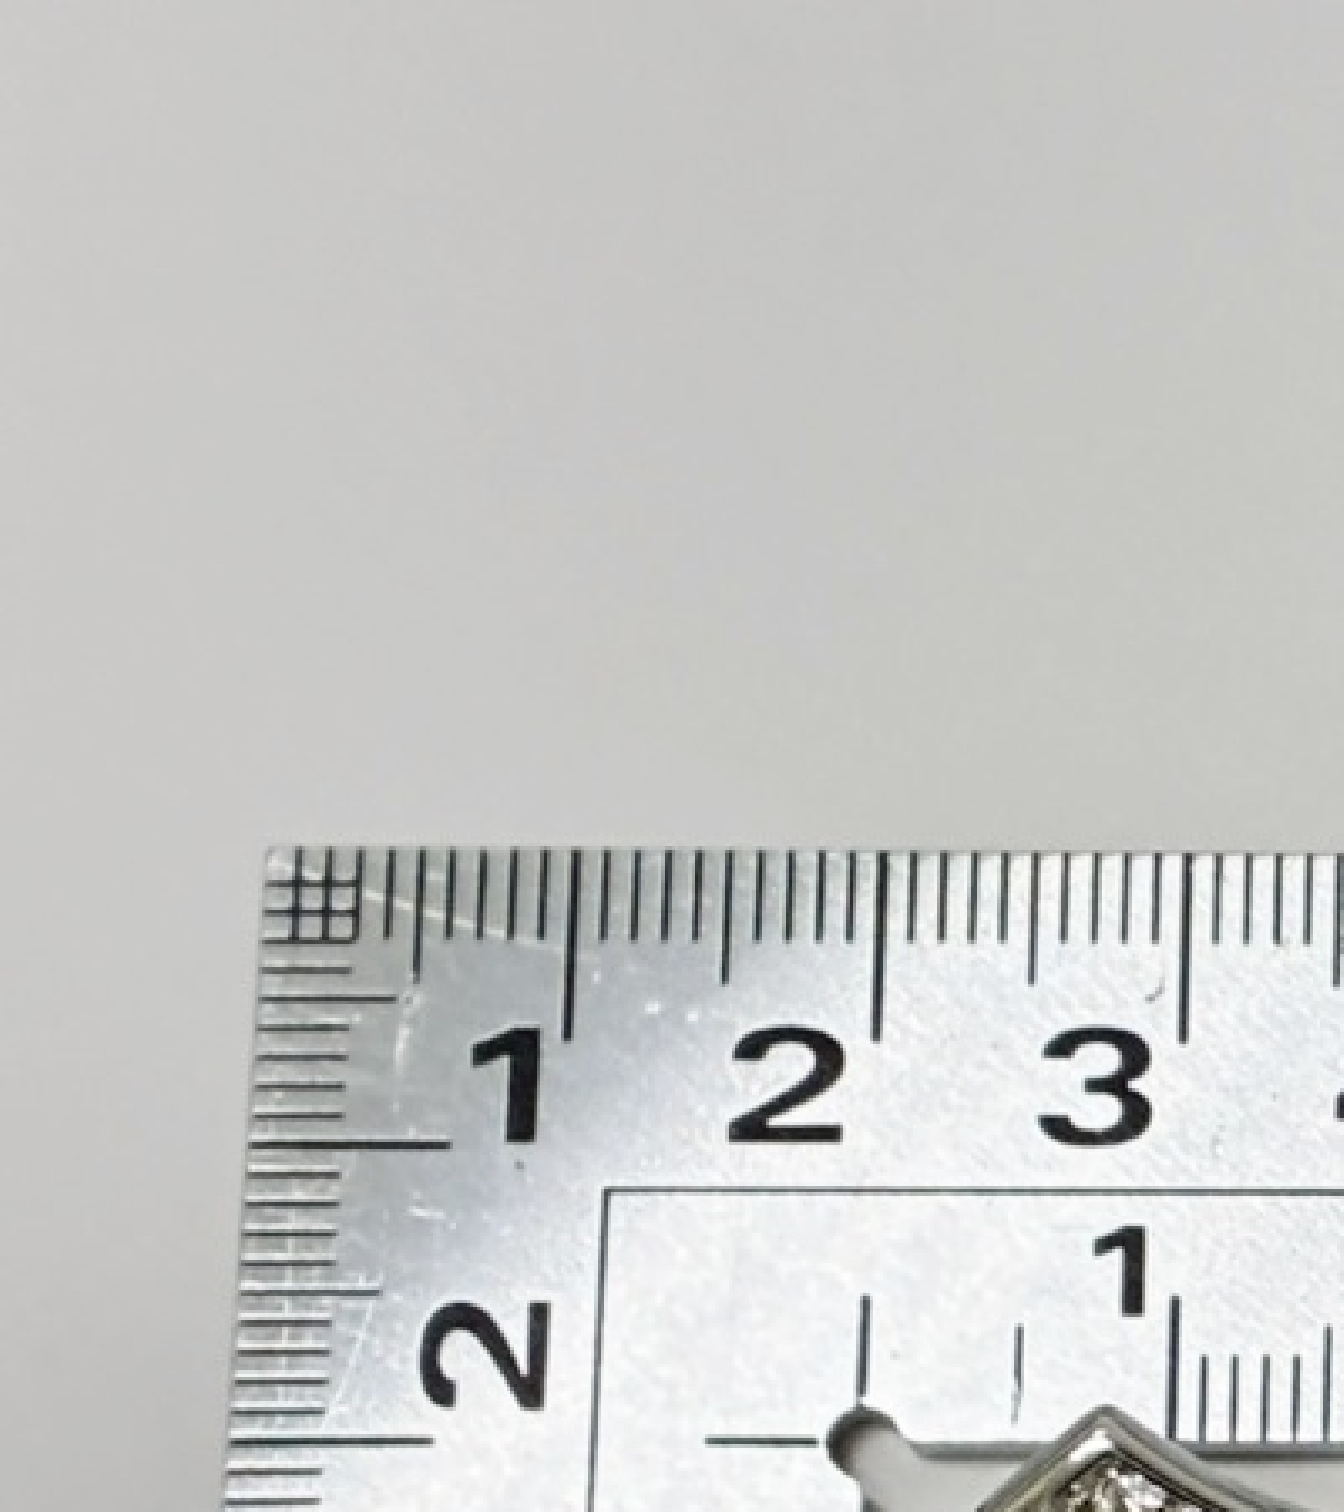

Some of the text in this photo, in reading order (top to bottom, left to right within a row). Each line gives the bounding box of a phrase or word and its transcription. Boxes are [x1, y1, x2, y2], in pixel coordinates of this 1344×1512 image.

[471, 1027, 540, 1142] 1
[727, 1025, 845, 1143] 2
[1036, 1025, 1152, 1148] 3
[1090, 1226, 1146, 1317] 1
[419, 1301, 550, 1411] 2
